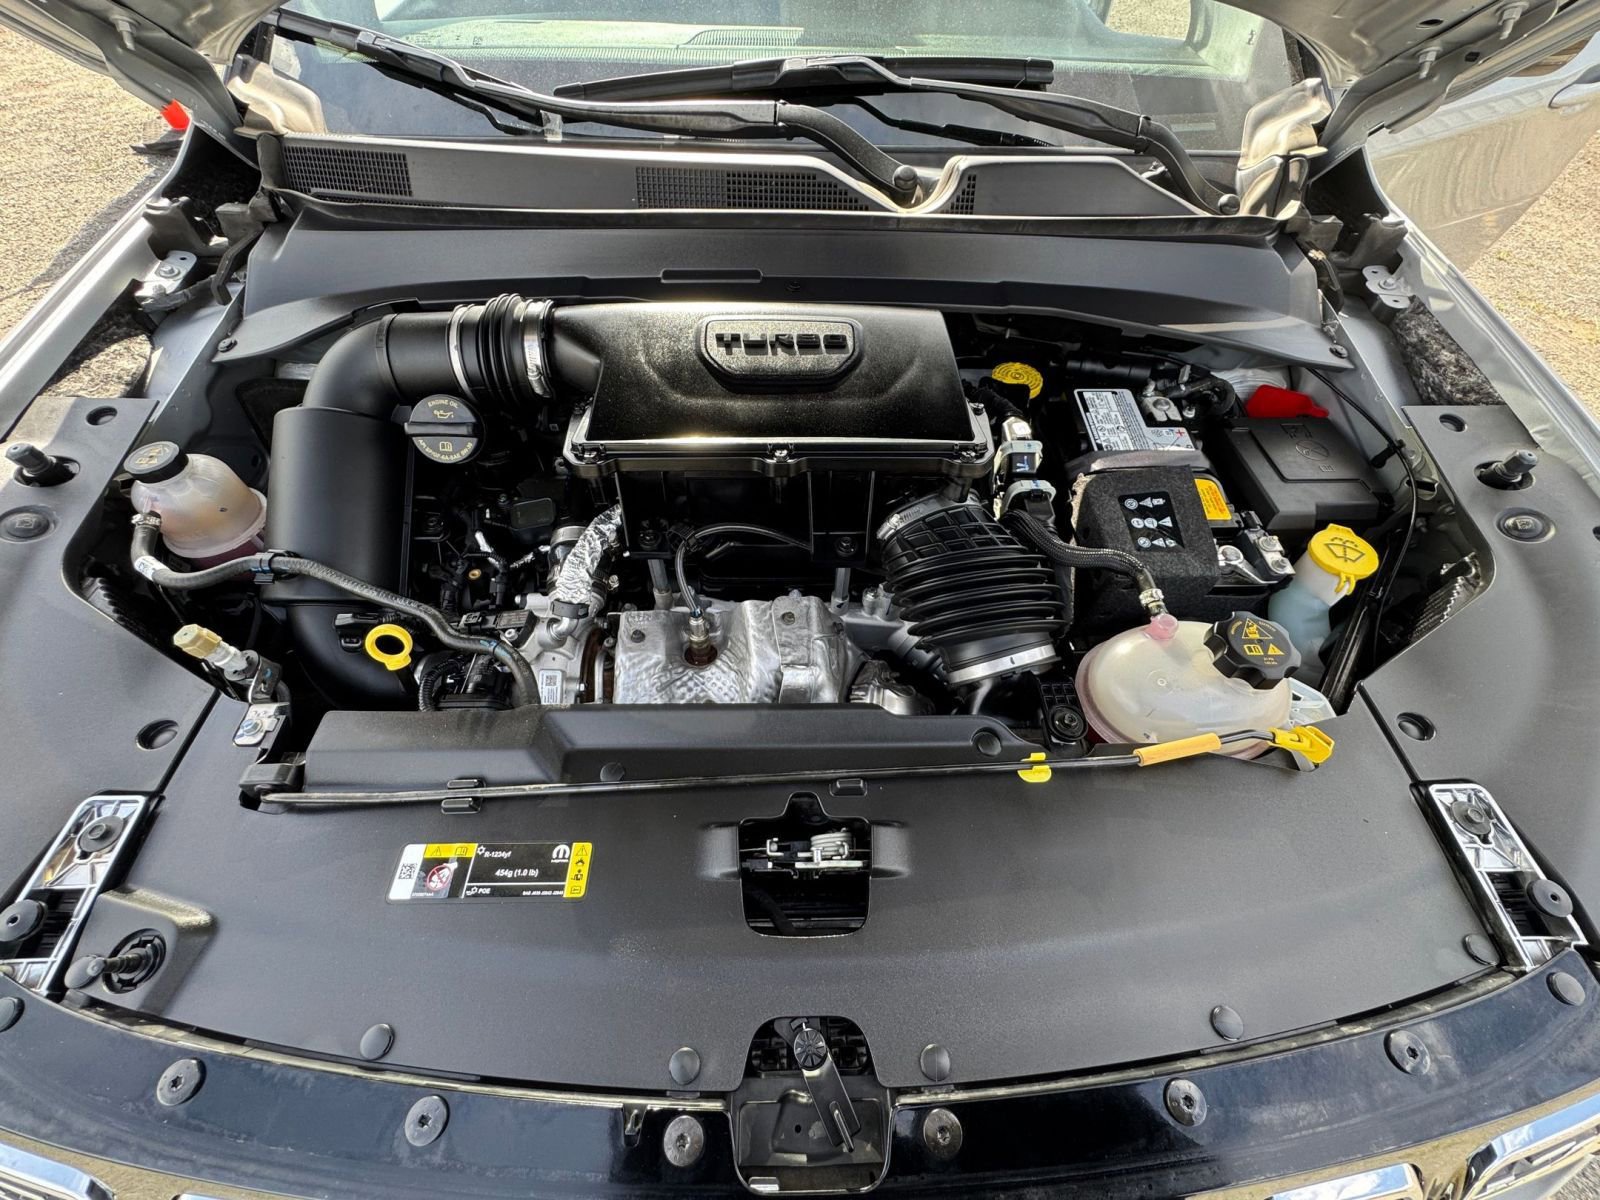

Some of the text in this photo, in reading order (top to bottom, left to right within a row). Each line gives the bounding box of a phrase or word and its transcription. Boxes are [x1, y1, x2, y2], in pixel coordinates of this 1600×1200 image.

[715, 333, 851, 355] TURBO
[427, 399, 459, 409] ENGINE OIL
[418, 439, 427, 449] API
[484, 851, 512, 859] R-1234yf
[495, 868, 539, 878] 454g (1.0 lb)
